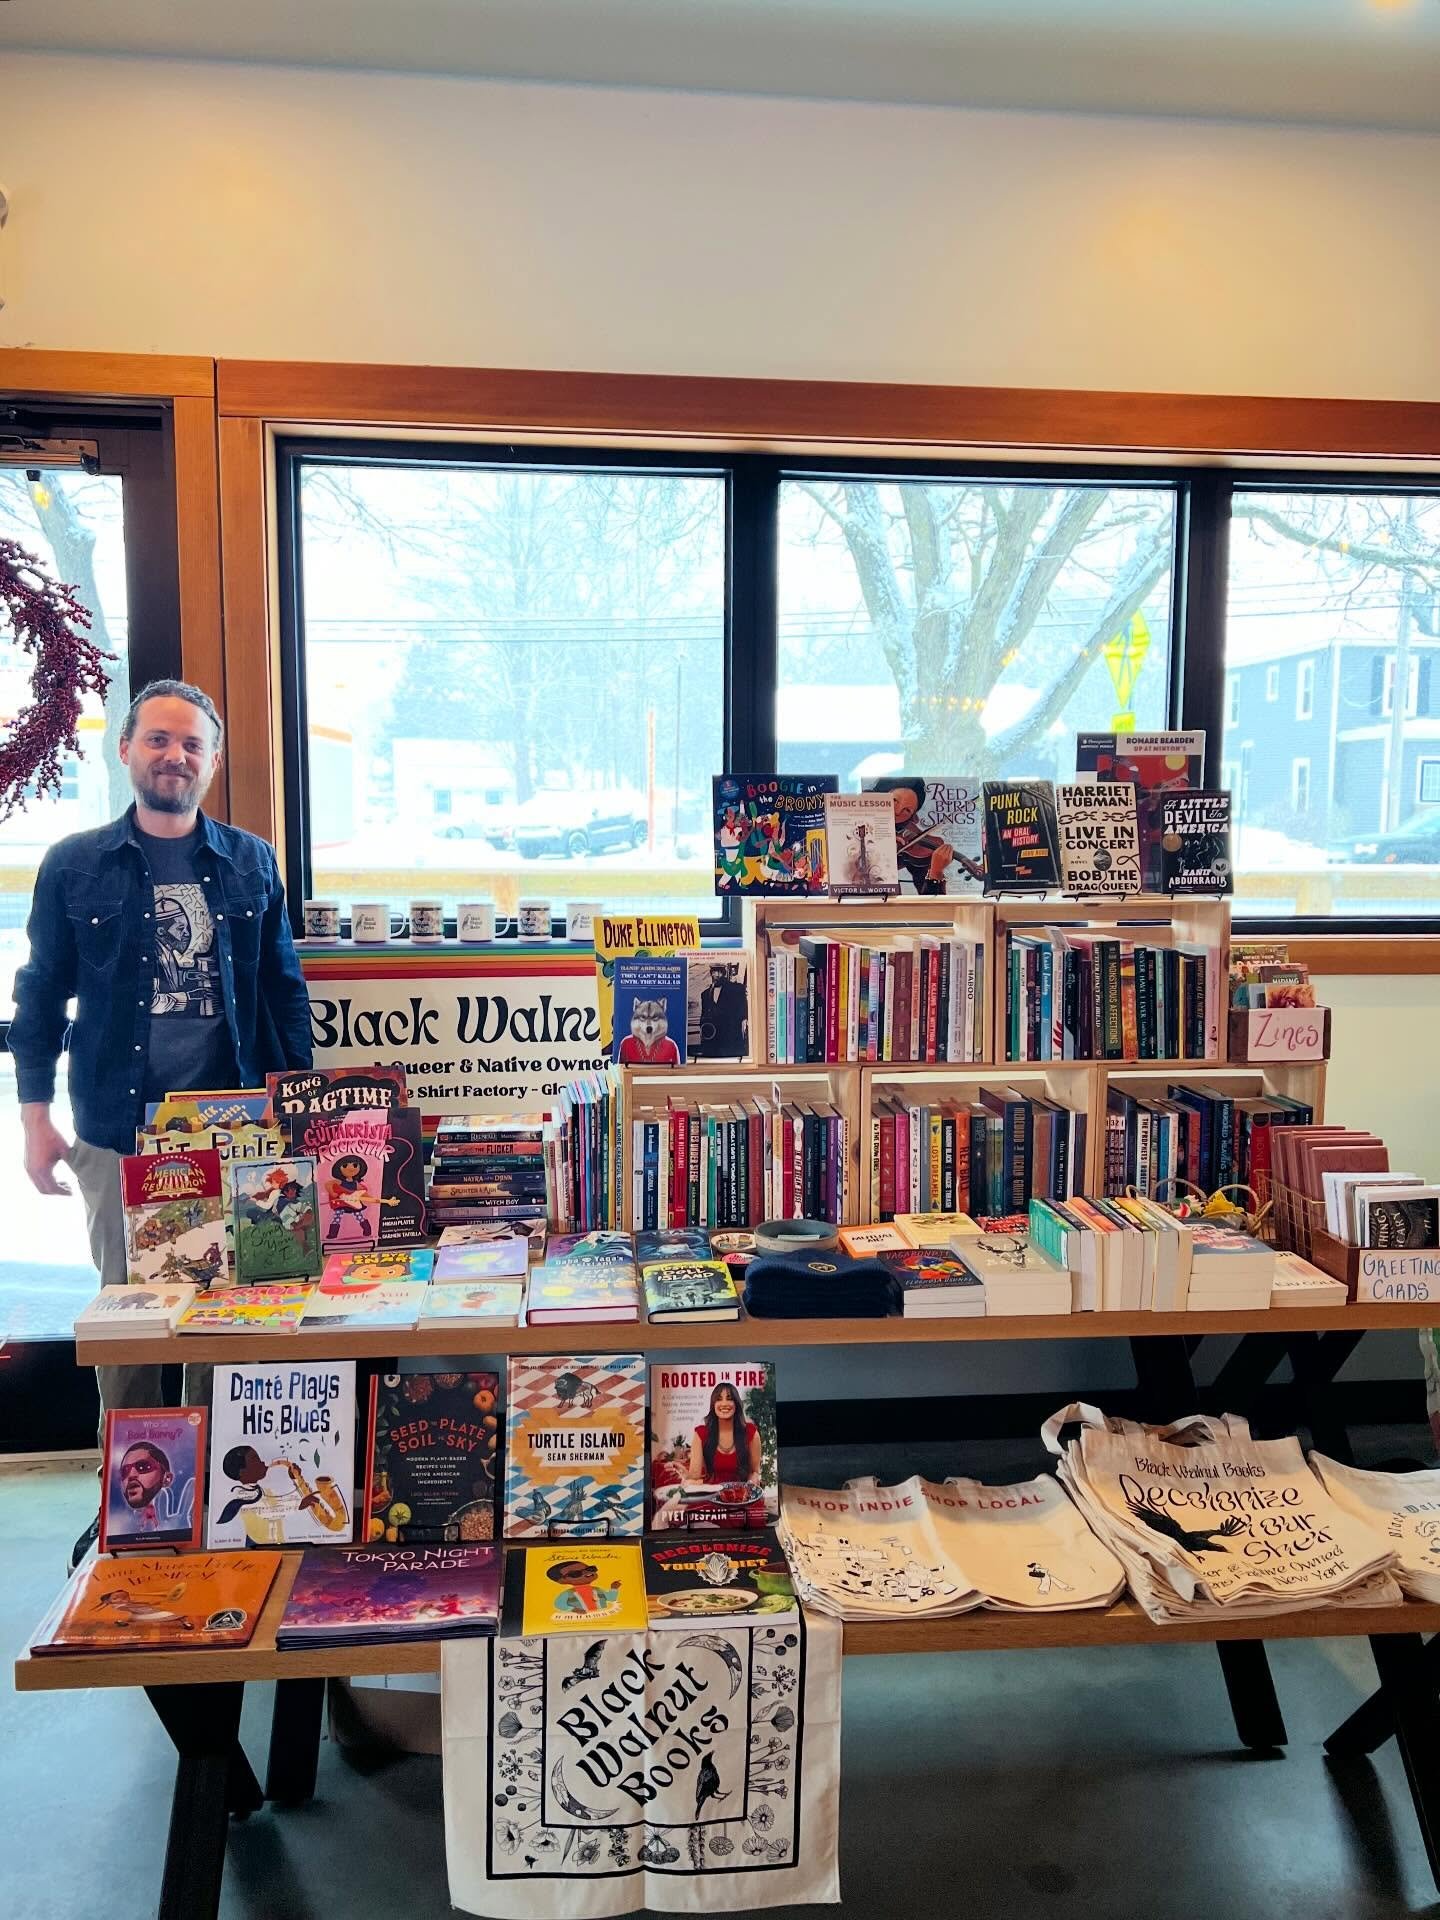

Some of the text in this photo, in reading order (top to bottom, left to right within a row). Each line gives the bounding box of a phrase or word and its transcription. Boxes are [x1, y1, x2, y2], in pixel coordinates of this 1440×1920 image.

[747, 782, 817, 799] BOOGIE in
[759, 795, 772, 804] the
[926, 783, 968, 801] RED
[1062, 786, 1131, 798] HARRIET
[830, 800, 892, 808] MUSIC LESSON
[935, 799, 976, 812] BIRD
[990, 793, 1021, 811] PUNK
[1064, 797, 1133, 807] TUBMAN:
[1179, 798, 1230, 809] LITTLE
[920, 810, 976, 828] SINGS
[1007, 807, 1038, 825] ROCK
[1164, 811, 1210, 825] DEVIL
[1003, 826, 1030, 840] AN ORAL
[1065, 826, 1134, 840] LIVE IN
[1164, 824, 1230, 835] AMERICA
[1066, 839, 1134, 850] CONCERT
[1067, 870, 1137, 881] BOB THE
[833, 887, 858, 895] VICTOR
[1102, 883, 1139, 891] QUEEN
[603, 919, 635, 949] DUKE
[636, 917, 696, 947] ELLINGTON
[1139, 975, 1147, 994] HAVE
[768, 961, 776, 1049] CARRY TONI JENSEN
[1108, 962, 1118, 1044] MONSTROUS AFFECTIONS
[309, 996, 601, 1048] Black Walnu
[1254, 1012, 1320, 1051] Zines
[460, 1058, 474, 1073] &
[477, 1056, 542, 1073] Native
[280, 1076, 321, 1098] KING
[417, 1084, 528, 1100] Shirt Factory
[281, 1087, 392, 1113] RAGTIME
[303, 1120, 394, 1147] GUITARRISTA
[486, 1144, 514, 1154] FLICKER
[677, 1117, 685, 1169] TEACHING RESISTANCE
[689, 1121, 700, 1183] BODIES UNDER SIEGE
[1141, 1130, 1149, 1160] PROPHETS
[1220, 1140, 1229, 1170] HEAVENS
[144, 1166, 205, 1182] AMERICAN
[1013, 1154, 1025, 1177] NICOLA
[141, 1178, 207, 1193] REVOLUTION
[463, 1175, 484, 1183] NAYRA
[960, 1169, 969, 1193] BALL
[1013, 1179, 1024, 1206] GRIFFITH
[1374, 1207, 1389, 1248] THINGS
[657, 1272, 715, 1282] ISLAND
[663, 1268, 707, 1276] DOLL
[1372, 1278, 1430, 1302] CARDS
[661, 1370, 765, 1388] ROOTED IN FIRE
[230, 1371, 340, 1408] Danté Plays
[242, 1404, 331, 1436] His Blues
[127, 1428, 184, 1442] Bad Bunny?
[390, 1418, 486, 1442] SEED PLATE
[397, 1433, 479, 1454] SOIL SKY
[527, 1432, 626, 1449] TURTLE ISLAND
[547, 1452, 605, 1461] SEAN SHERMAN
[1135, 1457, 1267, 1479] Black Walnut Books
[796, 1486, 1046, 1513] SHOP INDIE SHOP LOCAL
[1119, 1473, 1305, 1512] Decolonize
[661, 1509, 685, 1522] PYET
[342, 1546, 495, 1563] TOKYO NIGHT
[651, 1543, 772, 1562] DECOLONIZE
[383, 1558, 471, 1572] PARADE
[660, 1563, 705, 1572] YOUR
[1313, 1559, 1350, 1580] York
[556, 1645, 666, 1749] Black
[575, 1660, 709, 1788] Walnut
[616, 1704, 730, 1807] Books
